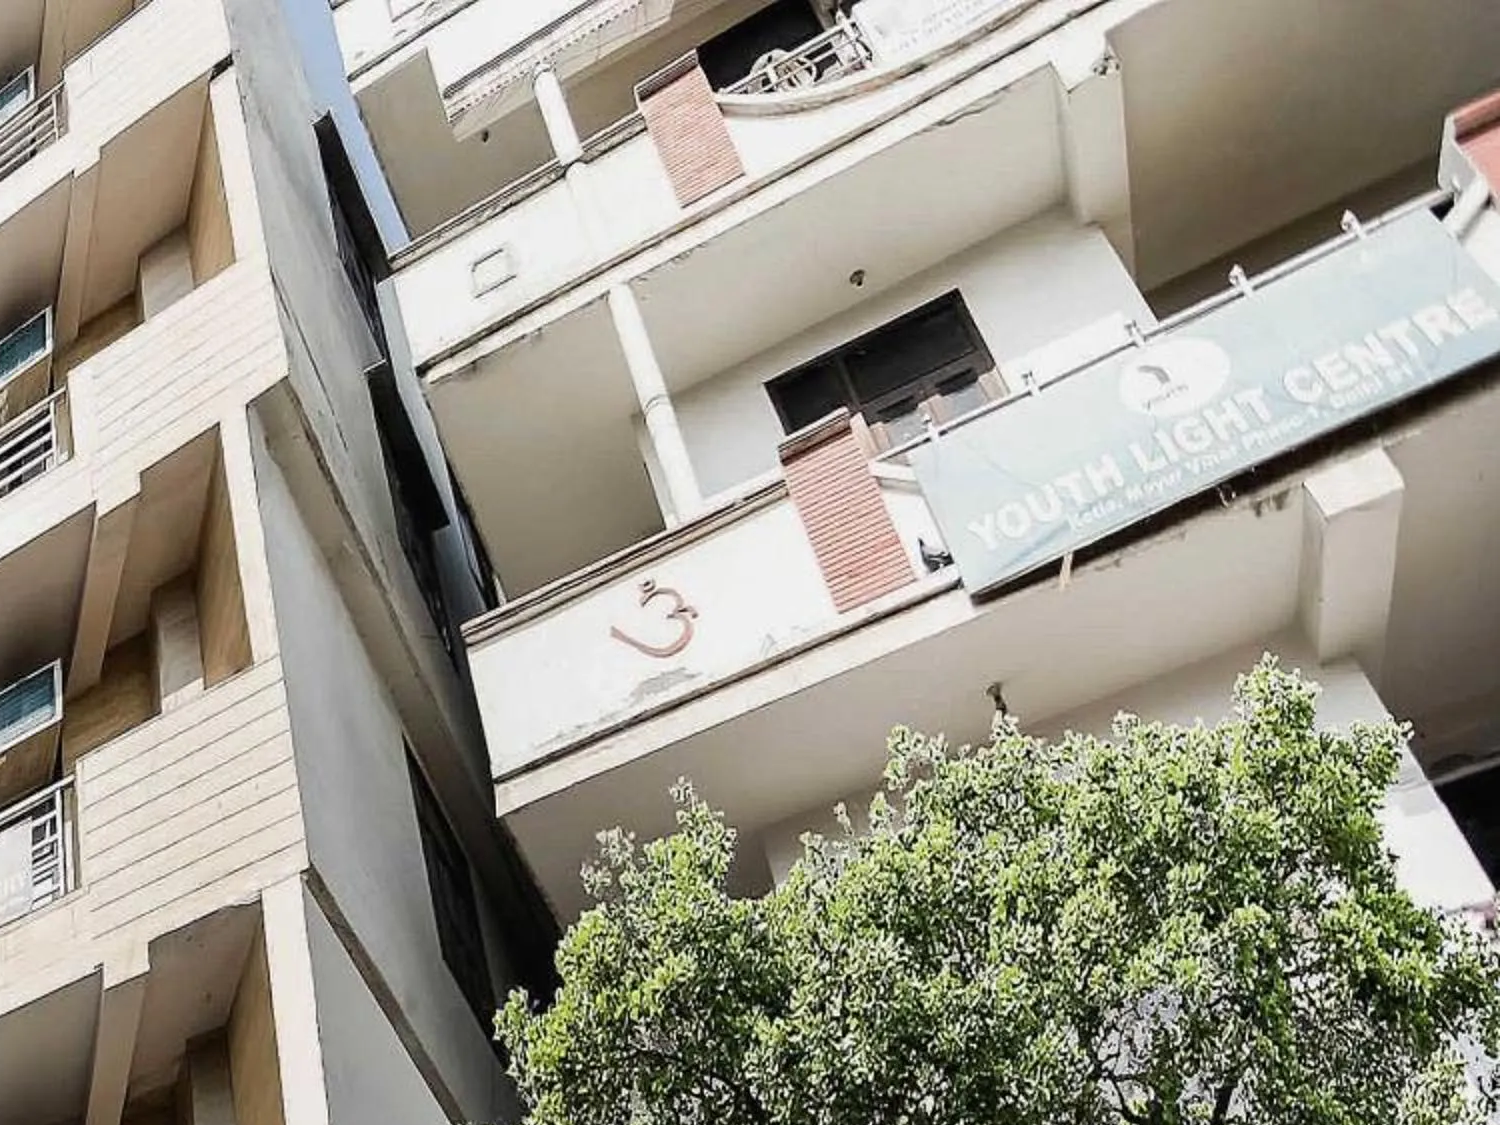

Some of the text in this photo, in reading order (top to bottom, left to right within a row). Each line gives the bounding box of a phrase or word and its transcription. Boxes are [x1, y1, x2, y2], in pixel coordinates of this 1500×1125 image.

[967, 288, 1499, 552] YOUTH LIGHT CENTRE
